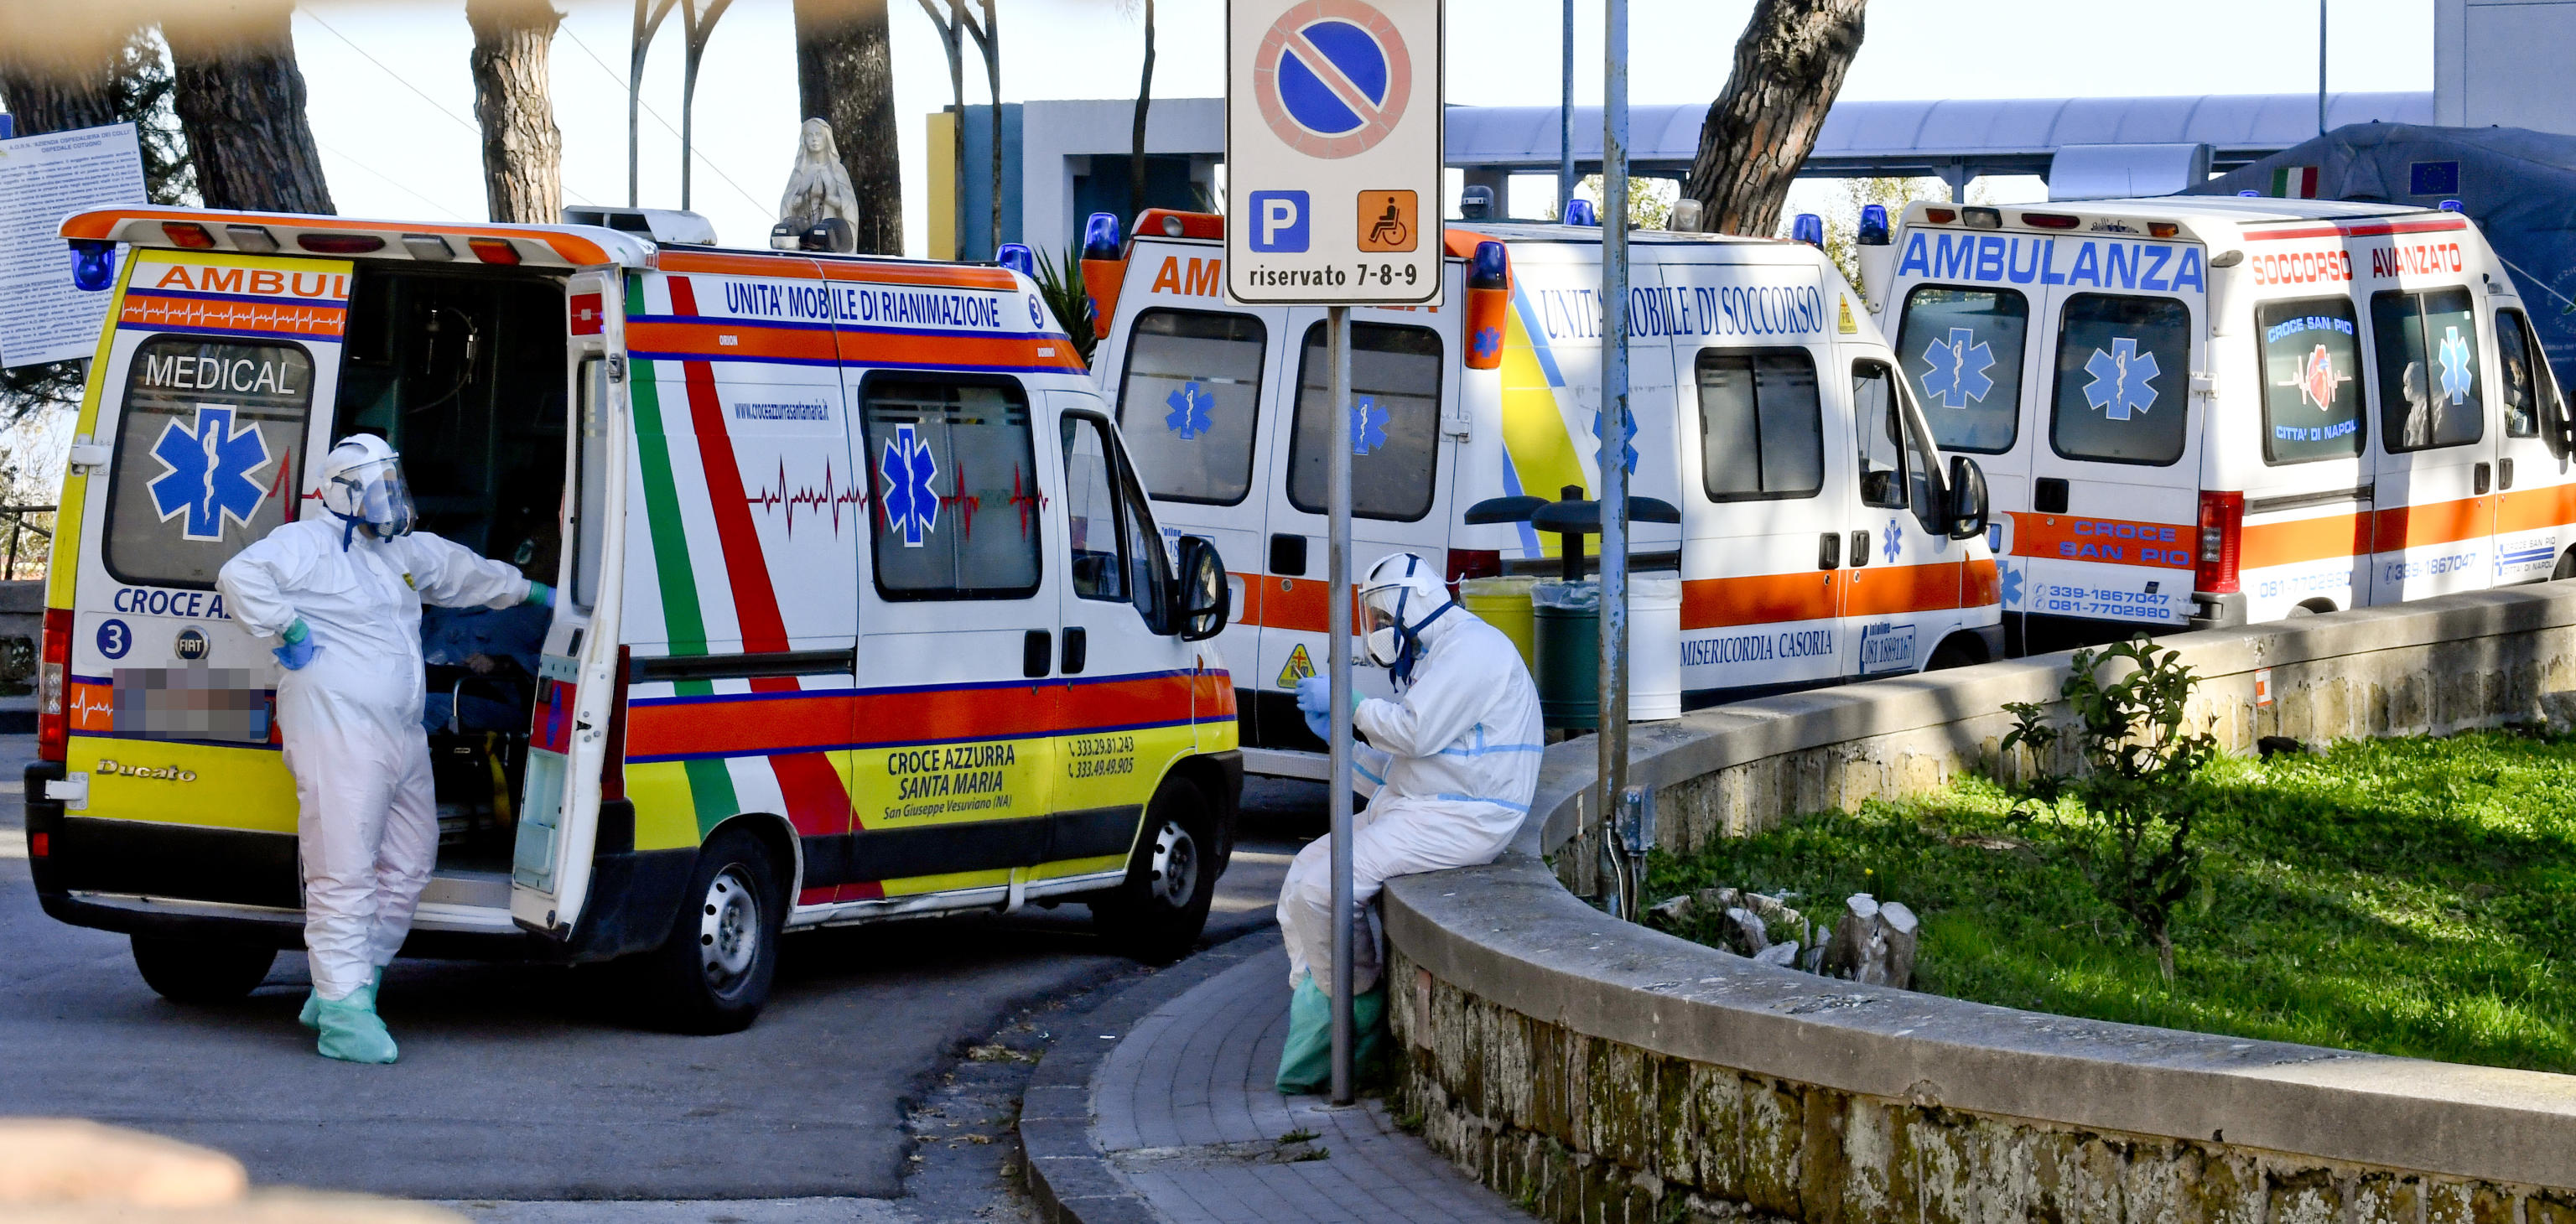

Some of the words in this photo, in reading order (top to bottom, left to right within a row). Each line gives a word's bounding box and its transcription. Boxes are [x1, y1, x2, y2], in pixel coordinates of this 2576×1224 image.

[1263, 199, 1297, 245] P
[1250, 265, 1345, 286] riservato
[1358, 264, 1417, 286] 7-8-9
[1898, 232, 2205, 293] AMBULANZA
[2252, 251, 2353, 285] SOCCORSO
[2372, 242, 2462, 278] AVANZATO
[726, 282, 782, 315] UNITA'
[788, 285, 859, 322] MOBILE
[860, 290, 879, 323] DI
[884, 292, 1000, 328] RIANIMAZIONE
[1031, 298, 1041, 324] 3
[1696, 288, 1722, 335] DI
[1722, 285, 1823, 335] SOCCORSO
[2267, 318, 2304, 344] CROCE
[2306, 316, 2330, 330] SAN
[2334, 318, 2353, 335] PIO
[145, 355, 295, 395] MEDICAL
[735, 398, 828, 421] www.croceazzurrasantamaria.it
[2276, 425, 2307, 441] CITTA'
[2310, 427, 2321, 441] DI
[2074, 521, 2176, 542] CROCE
[2059, 541, 2123, 560] SAN
[2141, 550, 2189, 566] PIO
[114, 589, 202, 617] CROCE
[2049, 586, 2170, 606] 339-1867047
[2049, 599, 2170, 620] 081-7702980
[106, 625, 122, 654] 3
[179, 639, 201, 651] FIAT
[1680, 635, 1774, 667] MISERICORDIA
[1779, 630, 1832, 657] CASORIA
[1865, 640, 1877, 664] 081
[1077, 736, 1134, 757] 333.29.81.243
[96, 759, 196, 782] Ducato
[888, 749, 940, 775] CROCE
[943, 744, 1015, 770] AZZURRA
[1075, 757, 1134, 779] 333.49.49.905
[898, 774, 948, 801] SANTA
[953, 770, 1003, 795] MARIA
[884, 806, 901, 820] San
[903, 802, 945, 819] Giuseppe
[947, 799, 991, 812] Vesuviano
[993, 795, 1012, 810] (NA)
